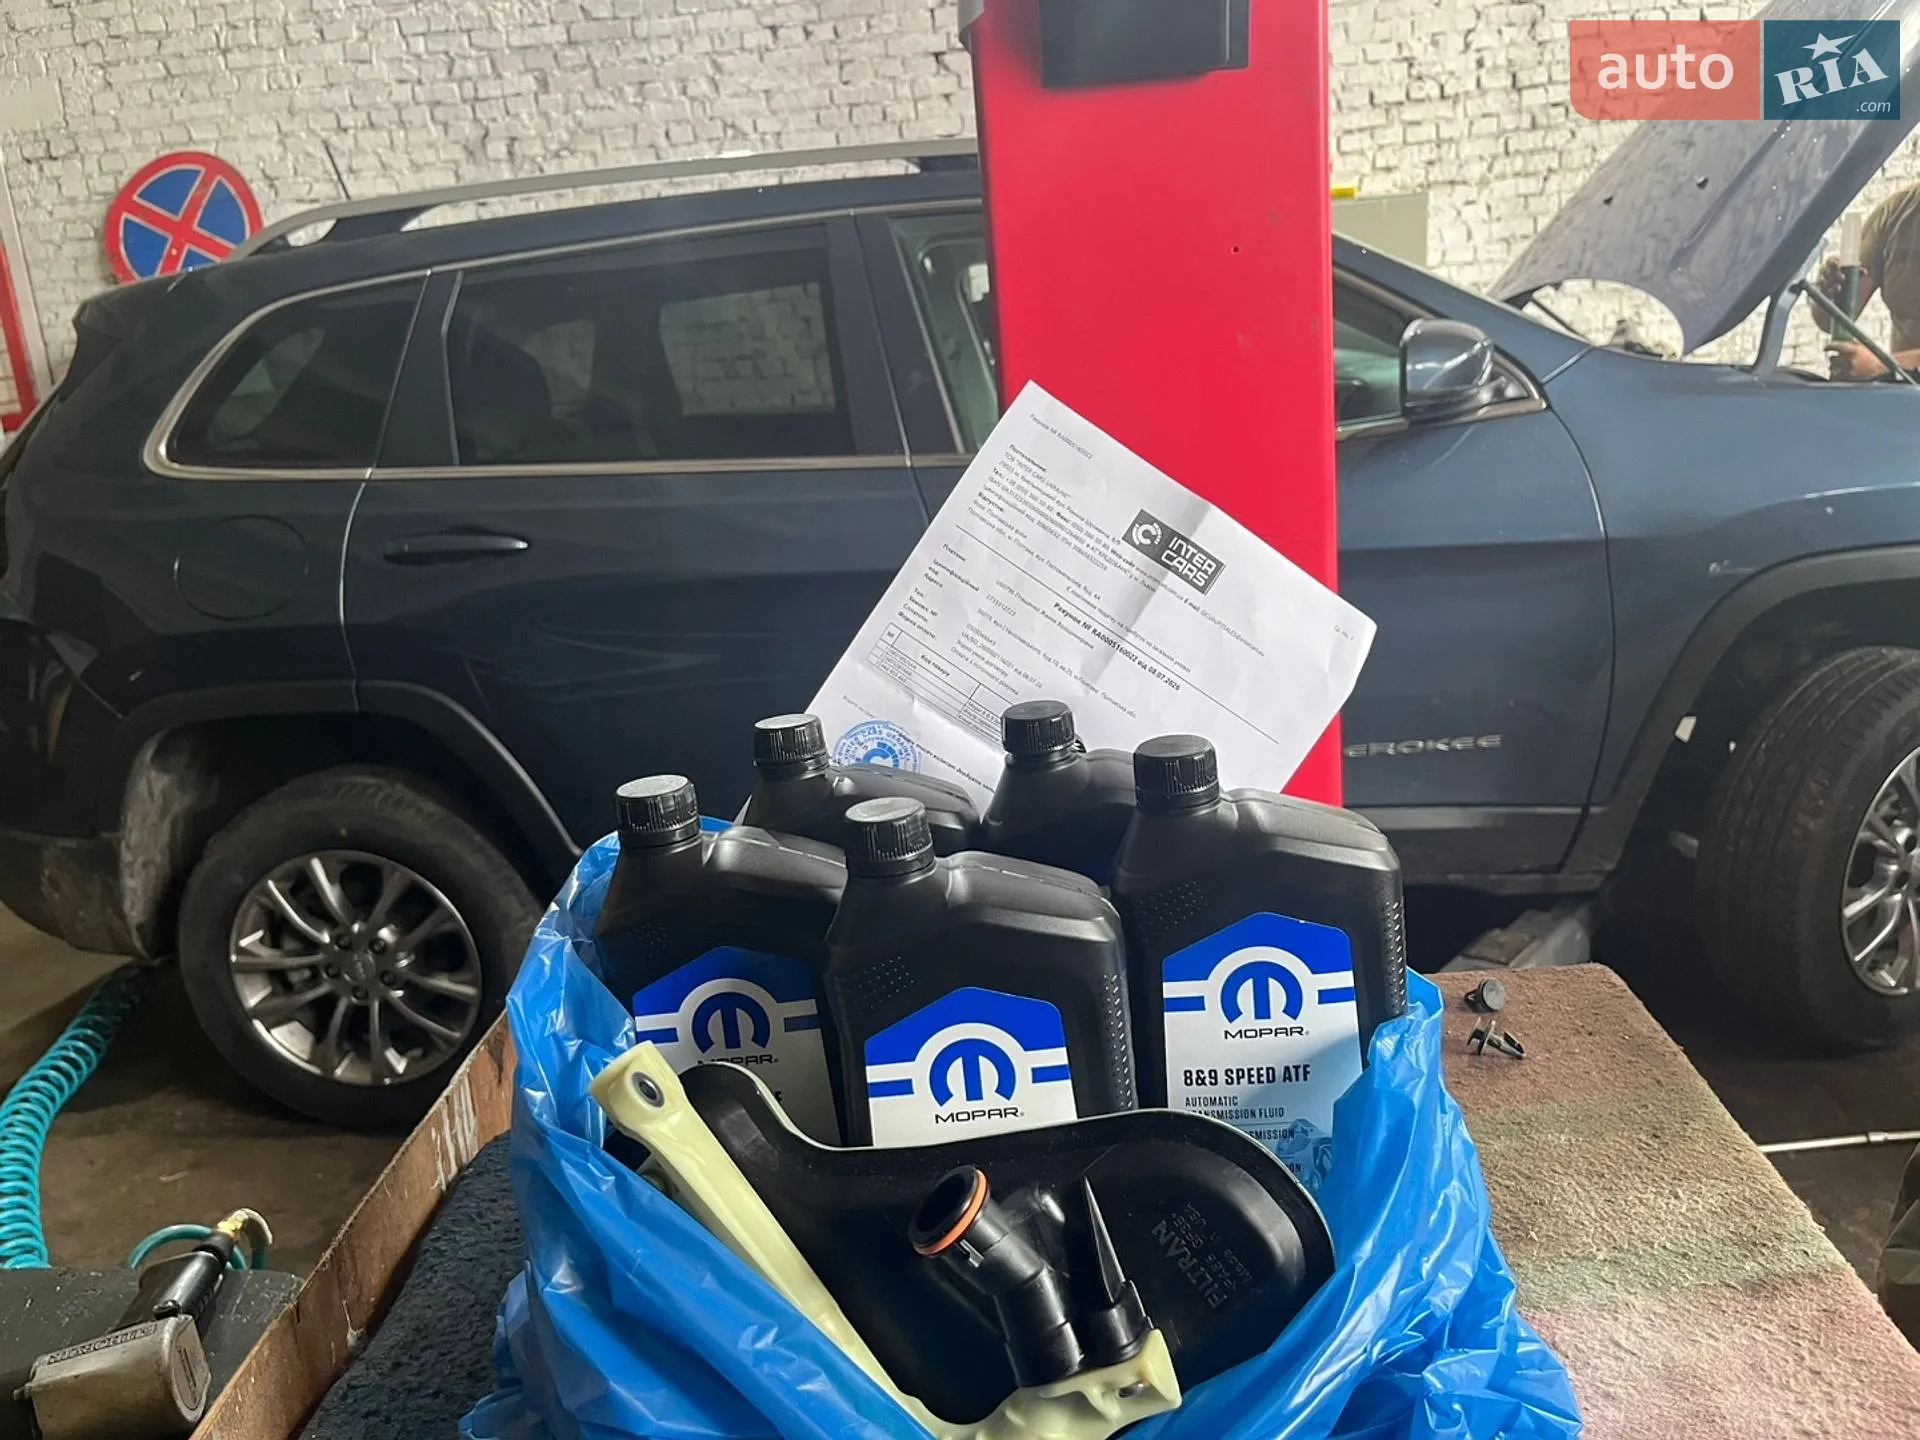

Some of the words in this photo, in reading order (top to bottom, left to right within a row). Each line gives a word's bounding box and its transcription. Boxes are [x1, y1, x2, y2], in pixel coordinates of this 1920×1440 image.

[1167, 536, 1218, 575] INTER
[1159, 548, 1209, 587] CARS
[1344, 734, 1502, 758] EROKEE
[1224, 1026, 1304, 1039] MOPAR
[698, 1054, 773, 1065] PAR
[1184, 1069, 1218, 1086] 8&9
[1225, 1067, 1276, 1085] SPEED
[1283, 1065, 1311, 1082] ATF
[1185, 1096, 1239, 1107] AUTOMATIC
[935, 1107, 1019, 1124] MOPAR
[1186, 1109, 1256, 1120] RANSMISSION
[1259, 1108, 1284, 1118] FLUID
